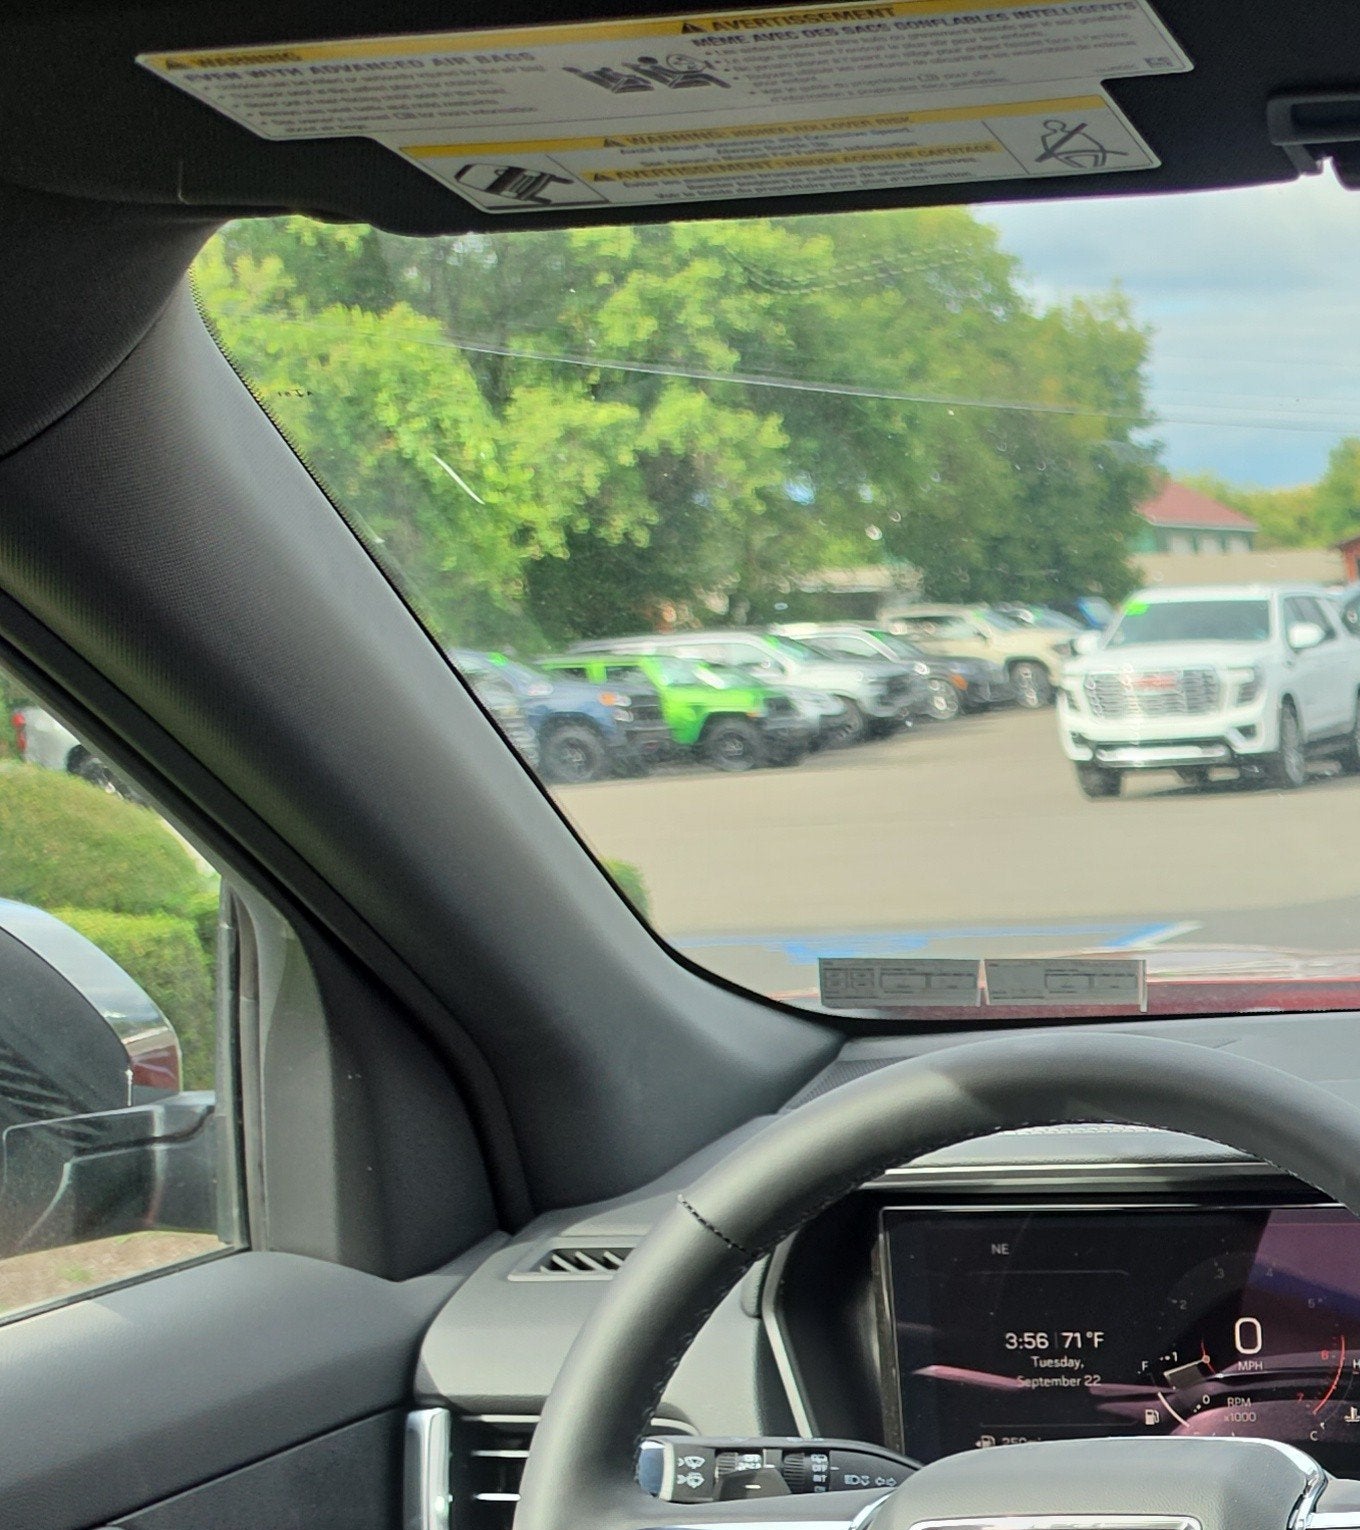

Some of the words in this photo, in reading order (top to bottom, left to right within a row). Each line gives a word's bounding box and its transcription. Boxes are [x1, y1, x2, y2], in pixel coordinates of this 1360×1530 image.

[712, 7, 896, 31] AVERTISSEMENT
[990, 1243, 1010, 1256] NE
[1005, 1332, 1050, 1350] 3:56
[1235, 1317, 1263, 1355] 0
[1030, 1355, 1085, 1371] Tuesday,
[1238, 1360, 1264, 1372] MPH
[1017, 1375, 1081, 1389] September
[1084, 1375, 1101, 1387] 22
[1227, 1397, 1251, 1408] RPM
[1224, 1412, 1258, 1422] x1000
